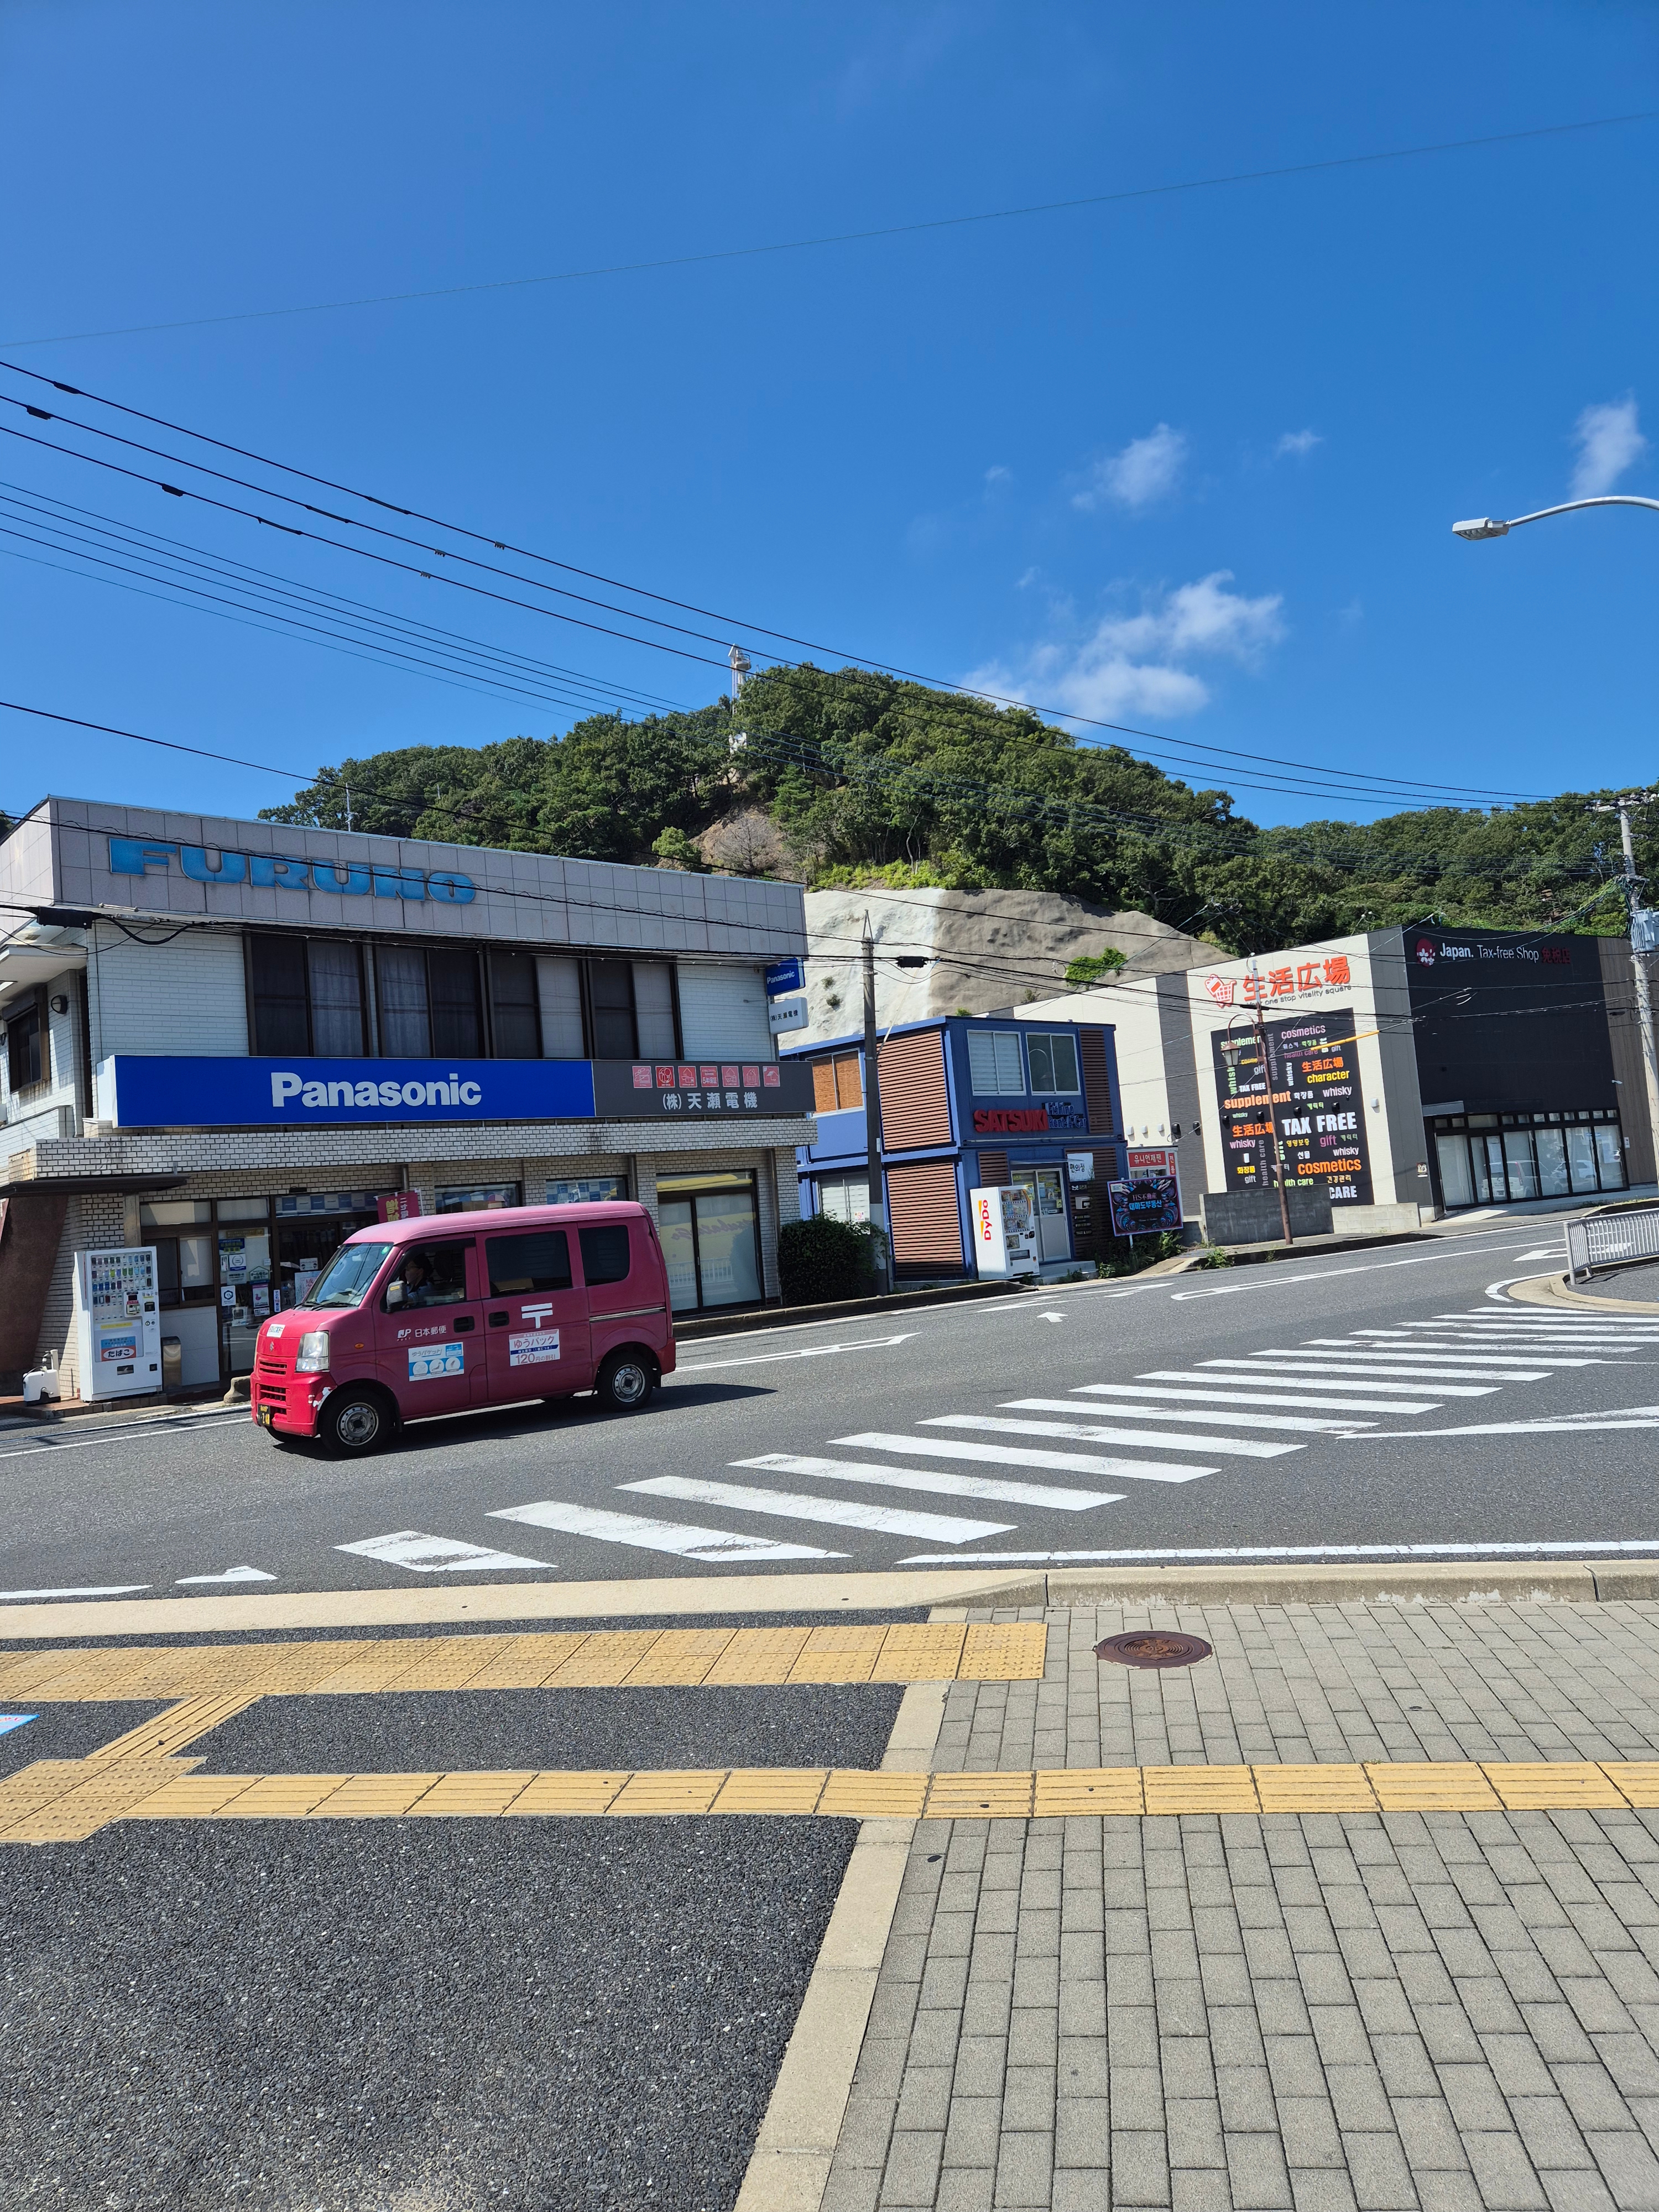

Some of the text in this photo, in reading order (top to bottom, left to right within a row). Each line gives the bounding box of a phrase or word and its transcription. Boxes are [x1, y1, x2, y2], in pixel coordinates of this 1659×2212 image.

[109, 837, 476, 905] FURUNO
[1439, 942, 1539, 963] Japan. Tax-free Shop
[1541, 946, 1571, 964] 免税店
[766, 971, 795, 984] Panasonic
[1244, 956, 1351, 1002] 生活広場
[1280, 995, 1296, 1005] stop
[1325, 985, 1352, 995] square
[1281, 1025, 1326, 1039] cosmetics
[1267, 1033, 1278, 1081] supplement
[1302, 1057, 1344, 1073] 生活広場
[1227, 1066, 1238, 1095] whisk
[1286, 1062, 1294, 1087] whisky
[1307, 1070, 1350, 1084] character
[270, 1072, 482, 1108] Panasonic
[1239, 1082, 1266, 1093] TAX FREE
[1323, 1086, 1352, 1098] whisky
[1293, 1091, 1314, 1100] 화장품
[1047, 1102, 1075, 1117] Fishing
[973, 1109, 1049, 1133] SATSUKI
[1281, 1112, 1358, 1136] TAX FREE
[1232, 1121, 1274, 1138] 生活広場
[1229, 1139, 1255, 1149] whisky
[1319, 1135, 1337, 1147] gift
[1297, 1151, 1311, 1160] 선물
[1333, 1146, 1359, 1156] whisky
[1134, 1153, 1162, 1164] 유니언재팬
[1237, 1165, 1256, 1174] 화장품
[1260, 1160, 1269, 1186] health
[1270, 1164, 1290, 1172] 캐터
[1297, 1158, 1362, 1175] cosmetics
[1244, 1175, 1257, 1184] gift
[1297, 1177, 1314, 1186] care
[1327, 1174, 1352, 1184] 건강관리
[1329, 1185, 1358, 1199] CARE
[1129, 1199, 1162, 1211] 대마도부동산
[982, 1199, 993, 1240] DyDo
[415, 1325, 447, 1338] 日本郵便
[514, 1335, 555, 1349] ゆうパック
[108, 1349, 130, 1358] たばこ
[515, 1353, 556, 1364] 120円の割引
